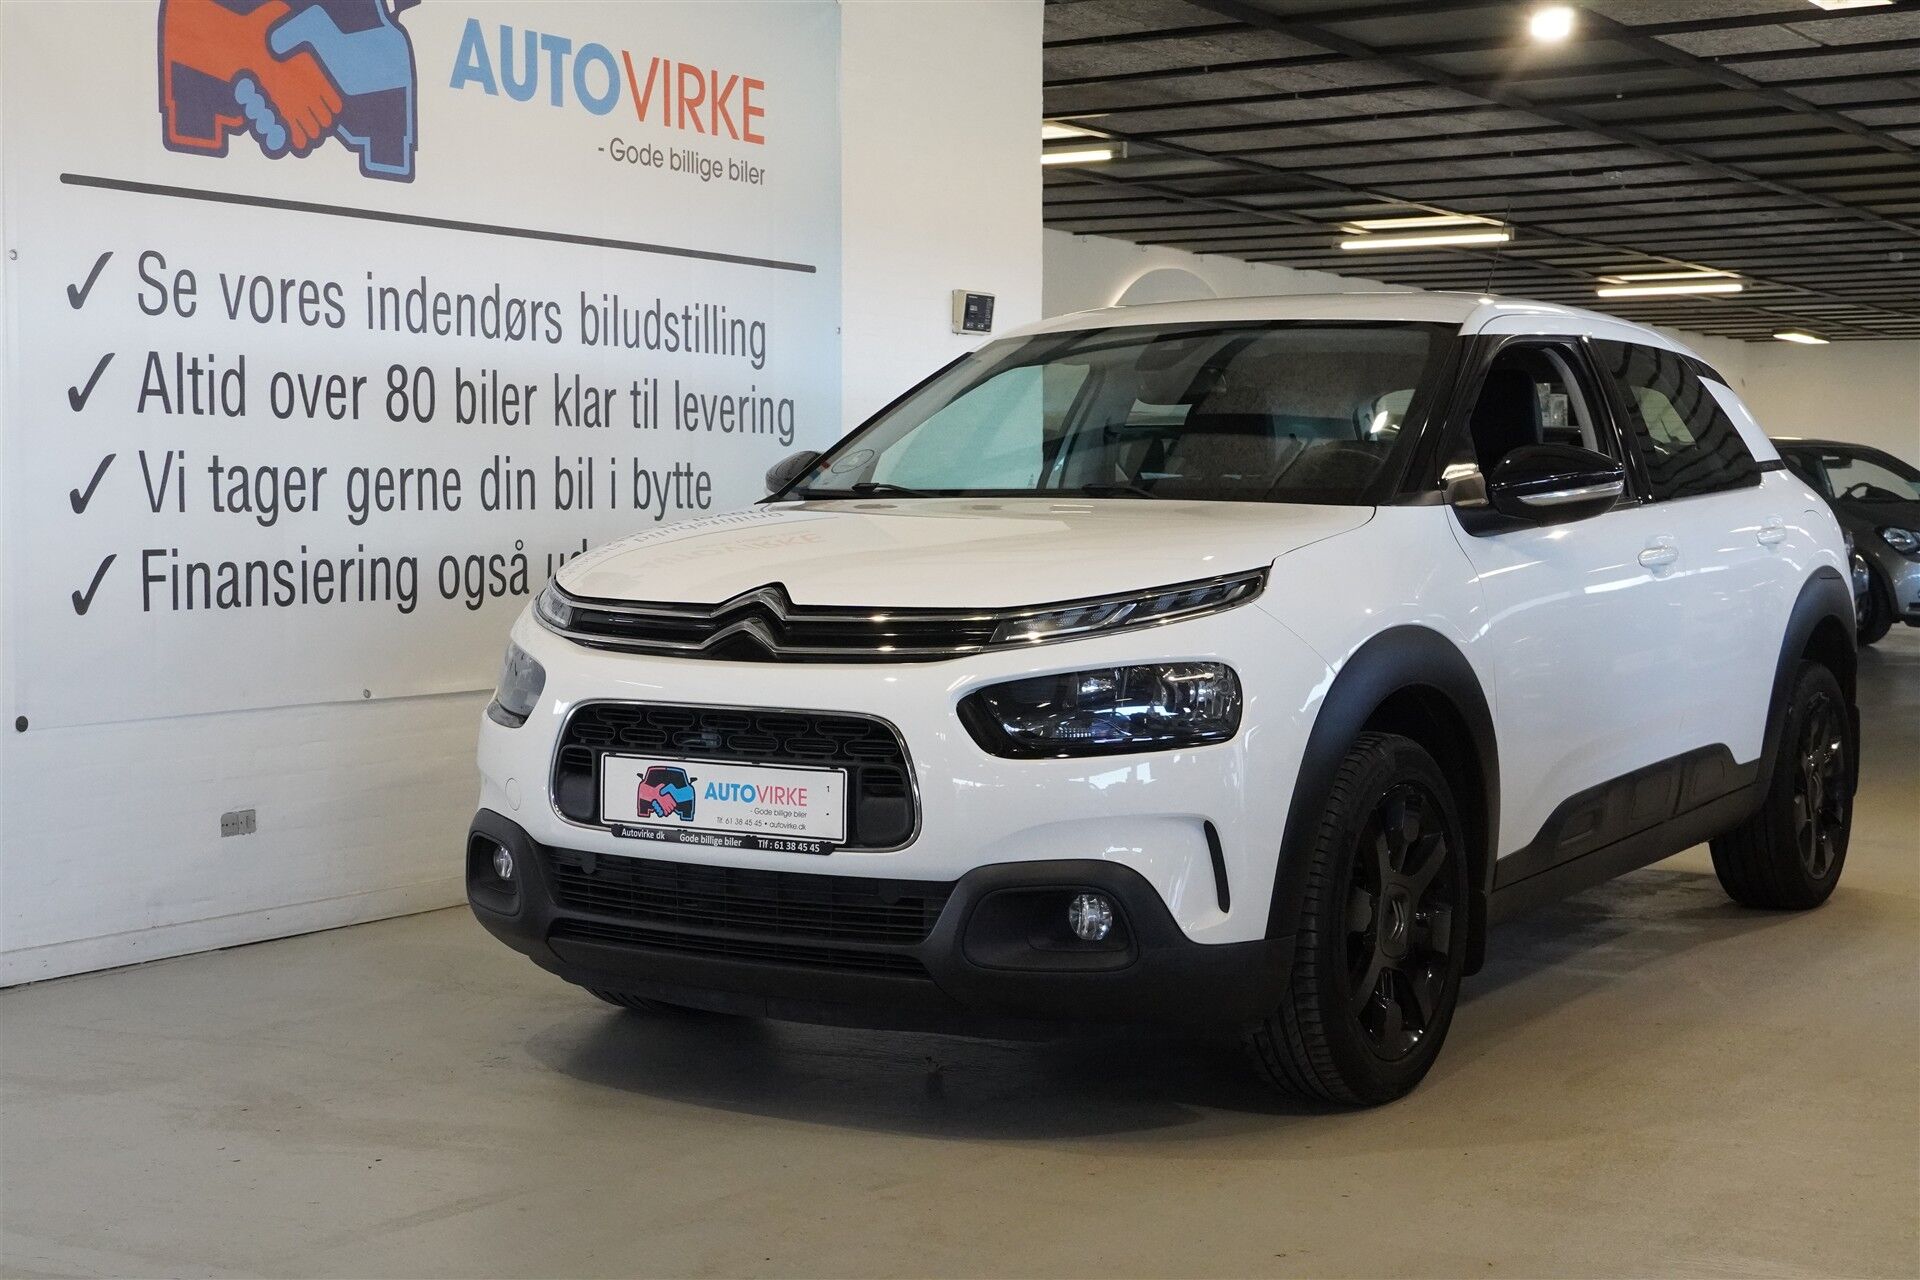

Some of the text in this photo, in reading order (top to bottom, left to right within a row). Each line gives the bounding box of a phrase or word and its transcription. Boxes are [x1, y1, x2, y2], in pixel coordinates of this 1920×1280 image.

[449, 18, 766, 146] AUTOVIRKE
[669, 146, 724, 183] billige
[728, 156, 766, 186] biler
[137, 250, 767, 370] Se vores indendørs biludstilling
[136, 350, 796, 447] Altid over 80 biler klar til levering
[138, 449, 713, 528] Vi tager gerne din bil i bytte
[141, 542, 418, 615] Finansiering
[438, 540, 531, 607] også
[704, 782, 808, 807] AUTOVIRKE
[774, 809, 793, 819] billige
[794, 810, 808, 819] biler
[679, 833, 742, 847] Gode billige biler
[725, 817, 733, 825] 61
[744, 819, 753, 827] 45
[754, 819, 763, 828] 45
[774, 840, 784, 850] 61
[785, 841, 796, 851] 38
[797, 842, 808, 852] 45
[809, 843, 820, 853] 45
